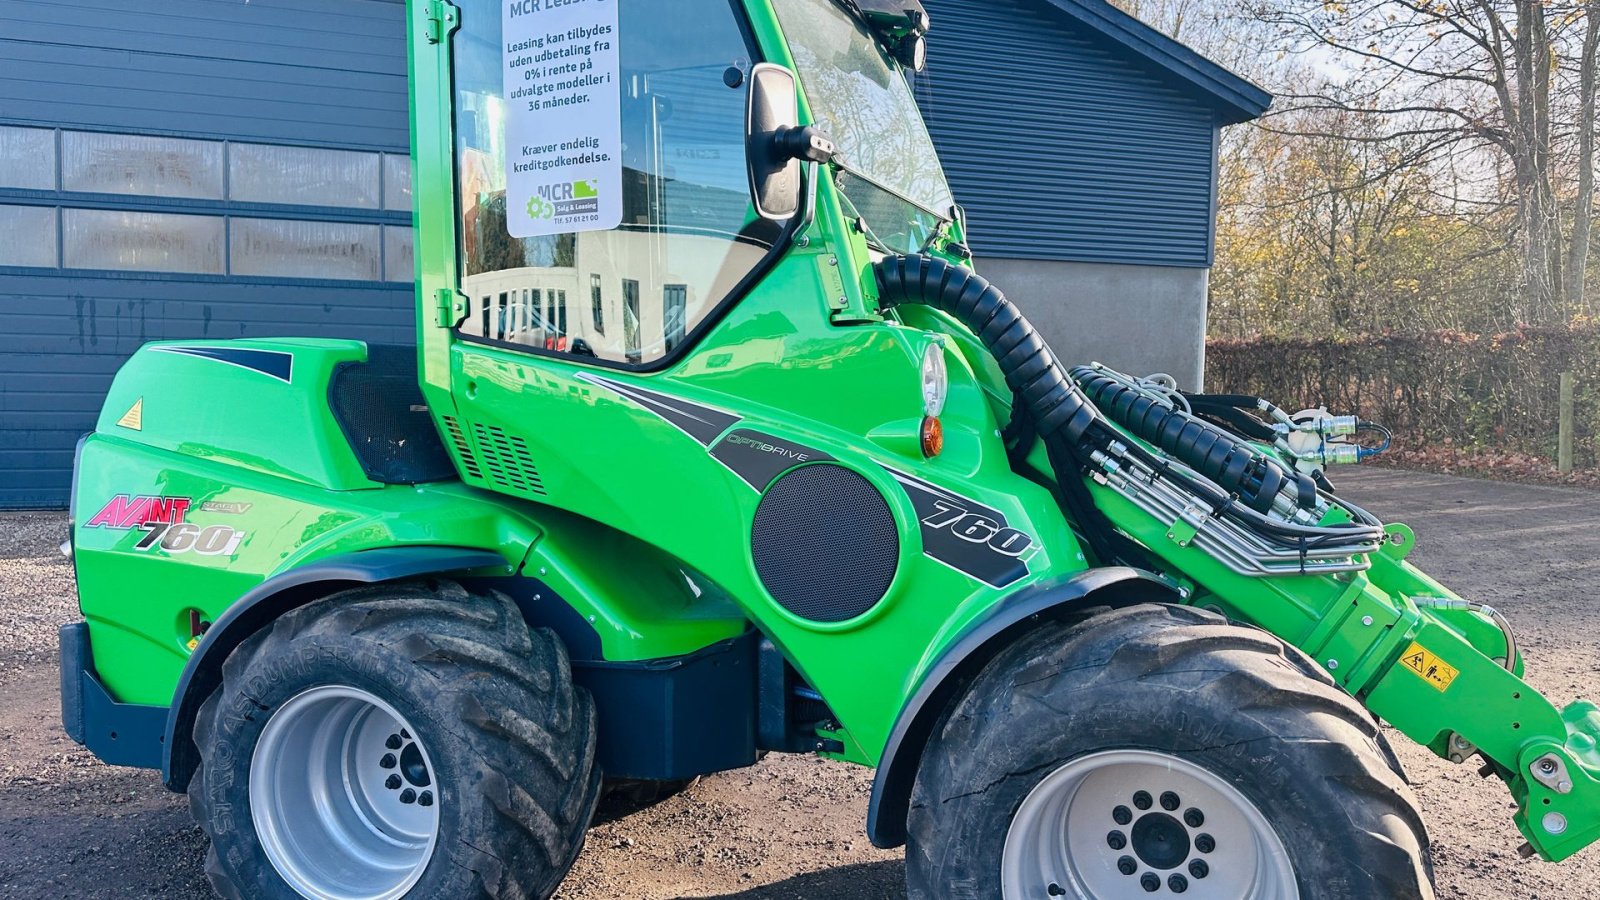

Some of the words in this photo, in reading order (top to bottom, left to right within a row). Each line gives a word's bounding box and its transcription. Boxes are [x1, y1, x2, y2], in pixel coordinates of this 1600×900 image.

[510, 0, 540, 18] MCR
[507, 38, 544, 53] Leasing
[546, 33, 565, 44] kan
[567, 24, 612, 41] tilbydes
[509, 56, 533, 68] uden
[535, 45, 591, 63] udbetaling
[594, 41, 610, 52] fra
[525, 68, 541, 81] 0%
[543, 67, 546, 77] i
[549, 63, 577, 76] rente
[580, 58, 593, 73] på
[511, 84, 554, 99] udvalgte
[557, 75, 604, 91] modeller
[607, 73, 610, 83] i
[528, 101, 540, 112] 36
[542, 93, 590, 109] måneder.
[522, 143, 557, 156] Kræver
[560, 137, 599, 151] endelig
[513, 152, 611, 173] kreditgodkendelse.
[538, 182, 573, 201] MCR
[576, 202, 597, 210] Leasing
[82, 493, 191, 529] AVANT
[134, 521, 245, 556] 760i
[921, 499, 1042, 563] 760i
